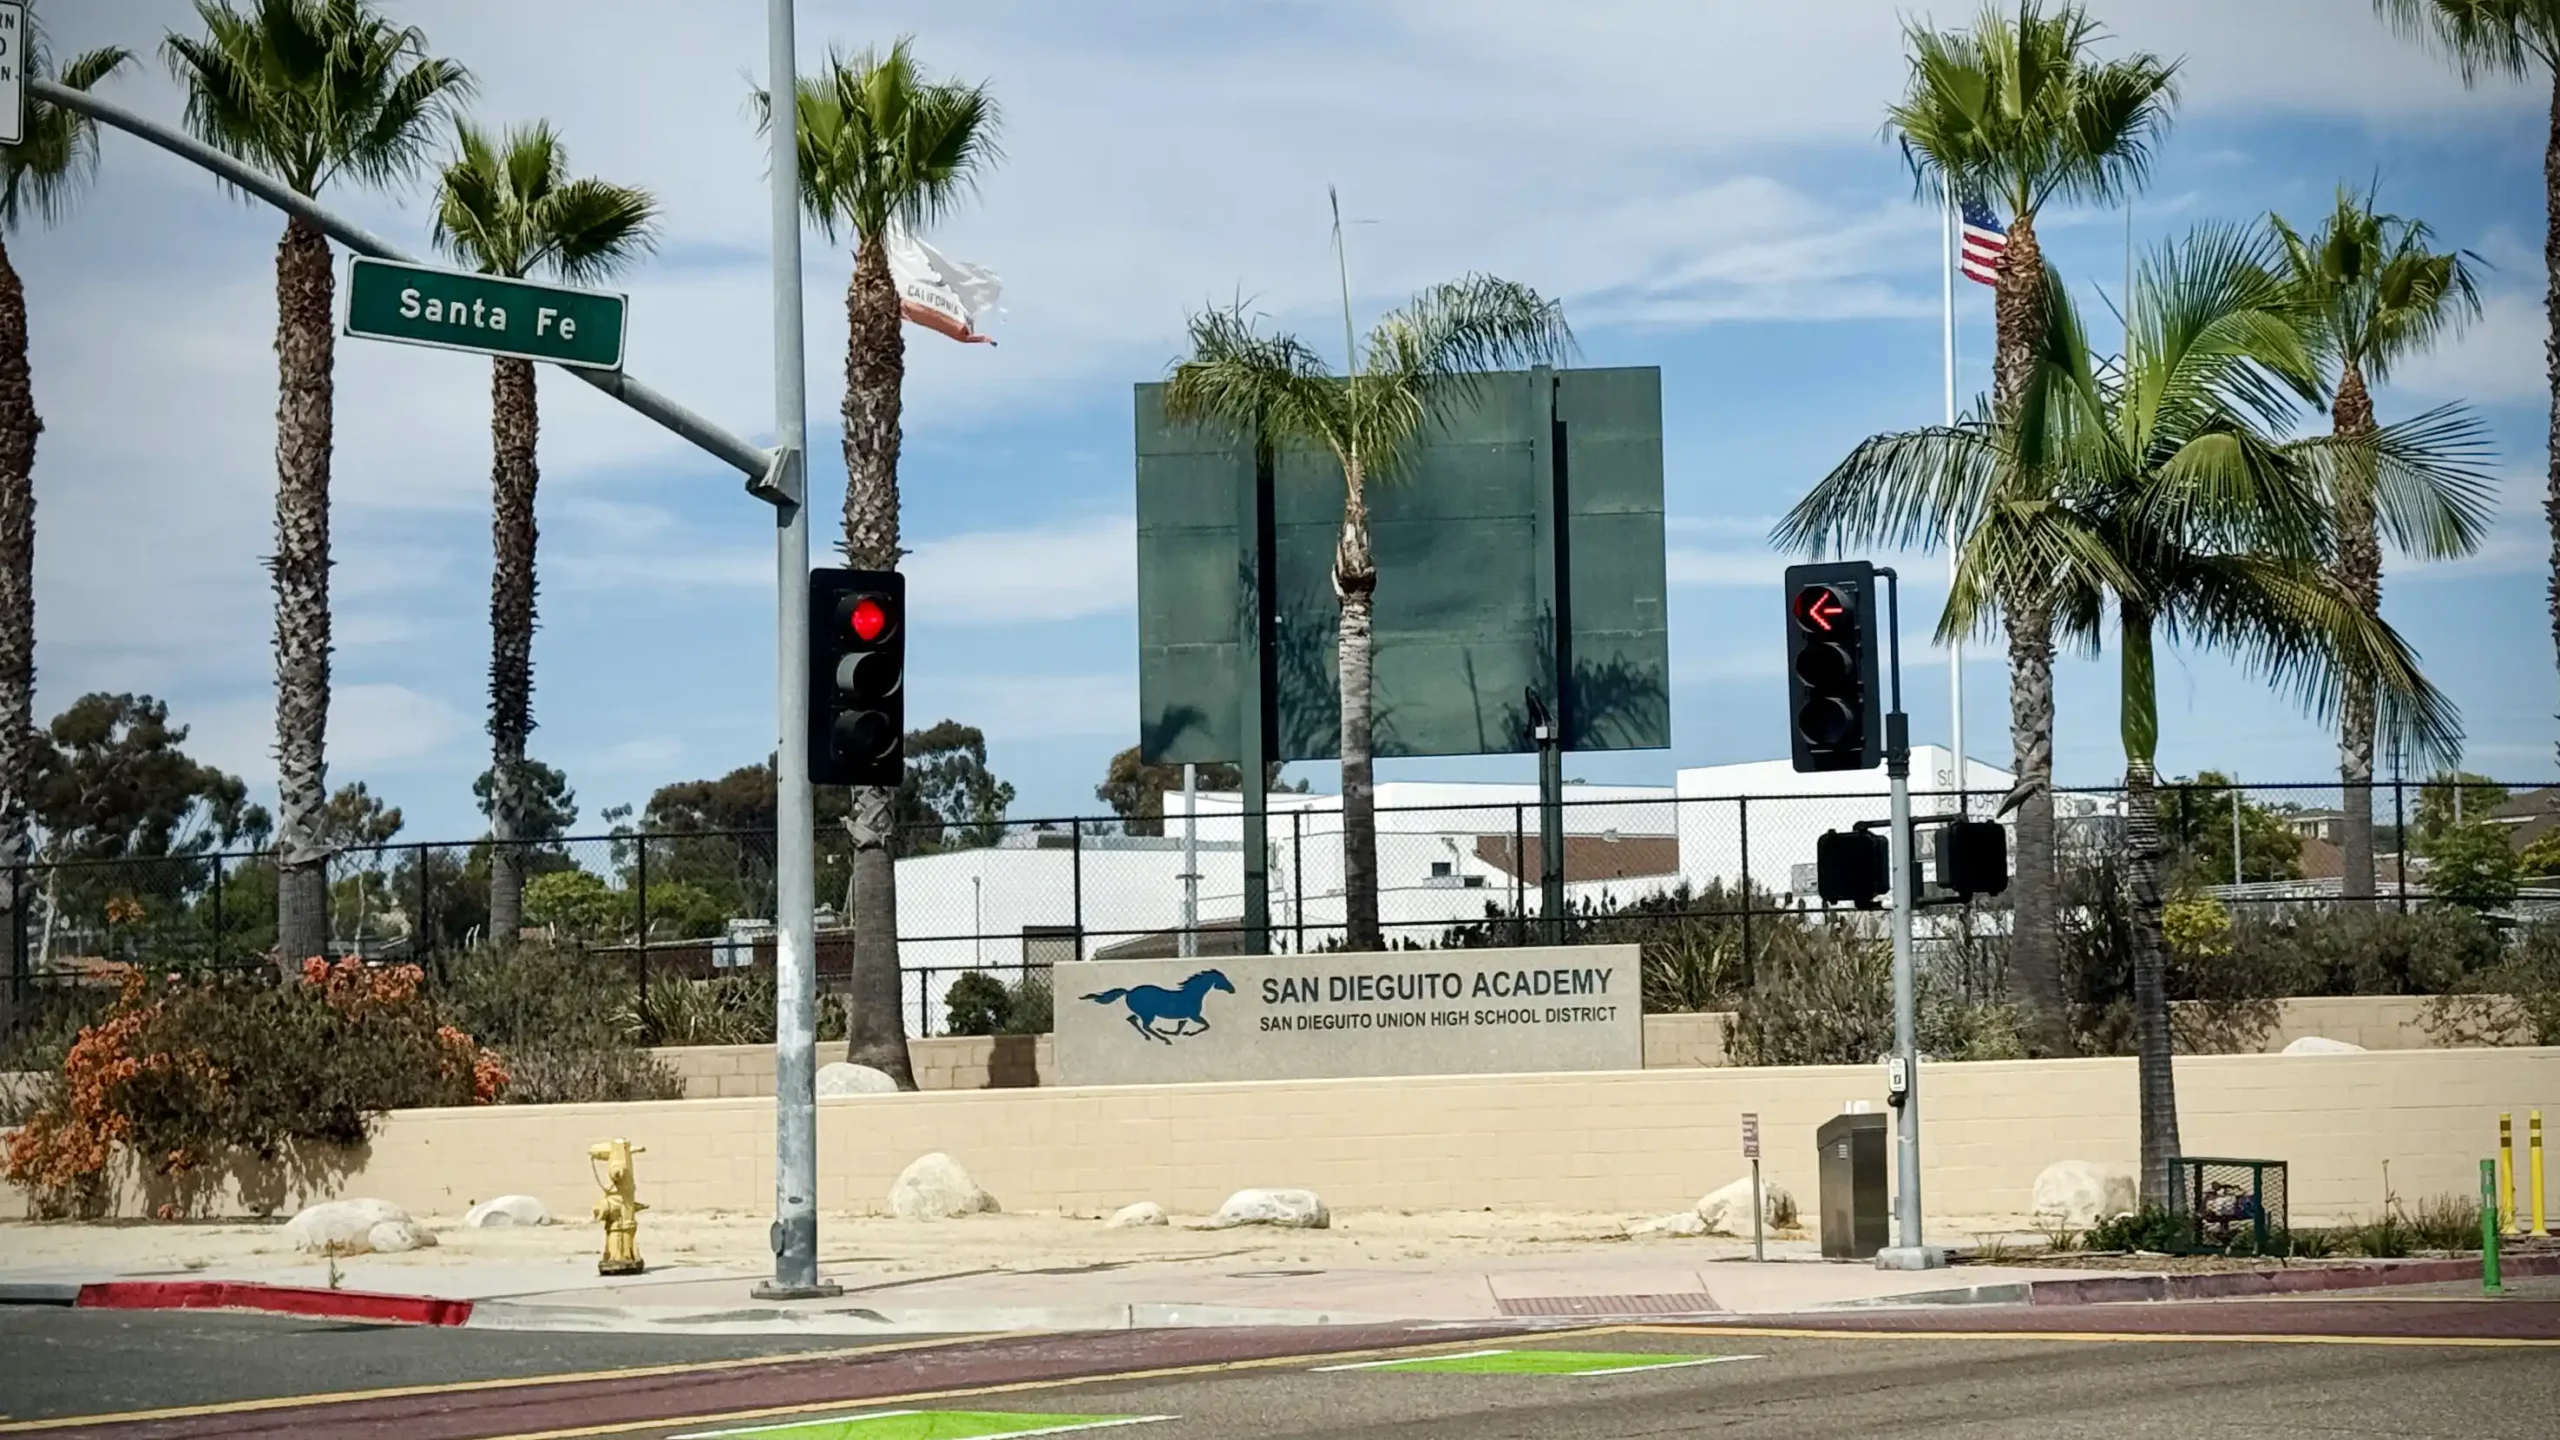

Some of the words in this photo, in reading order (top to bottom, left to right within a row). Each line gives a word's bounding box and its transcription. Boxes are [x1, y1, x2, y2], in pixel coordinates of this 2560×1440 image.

[399, 287, 507, 331] Santa
[537, 307, 577, 340] Fe
[908, 285, 959, 315] CALIFORNIA
[1262, 976, 1319, 1005] SAN
[1329, 972, 1463, 1003] DIEGUITO
[1471, 967, 1613, 999] ACADEMY
[1259, 1015, 1292, 1032] SAN
[1297, 1013, 1372, 1031] DIEGUITO
[1376, 1012, 1426, 1029] UNION
[1431, 1010, 1469, 1026] HIGH
[1474, 1008, 1540, 1026] SCHOOL
[1545, 1006, 1617, 1024] DISTRICT
